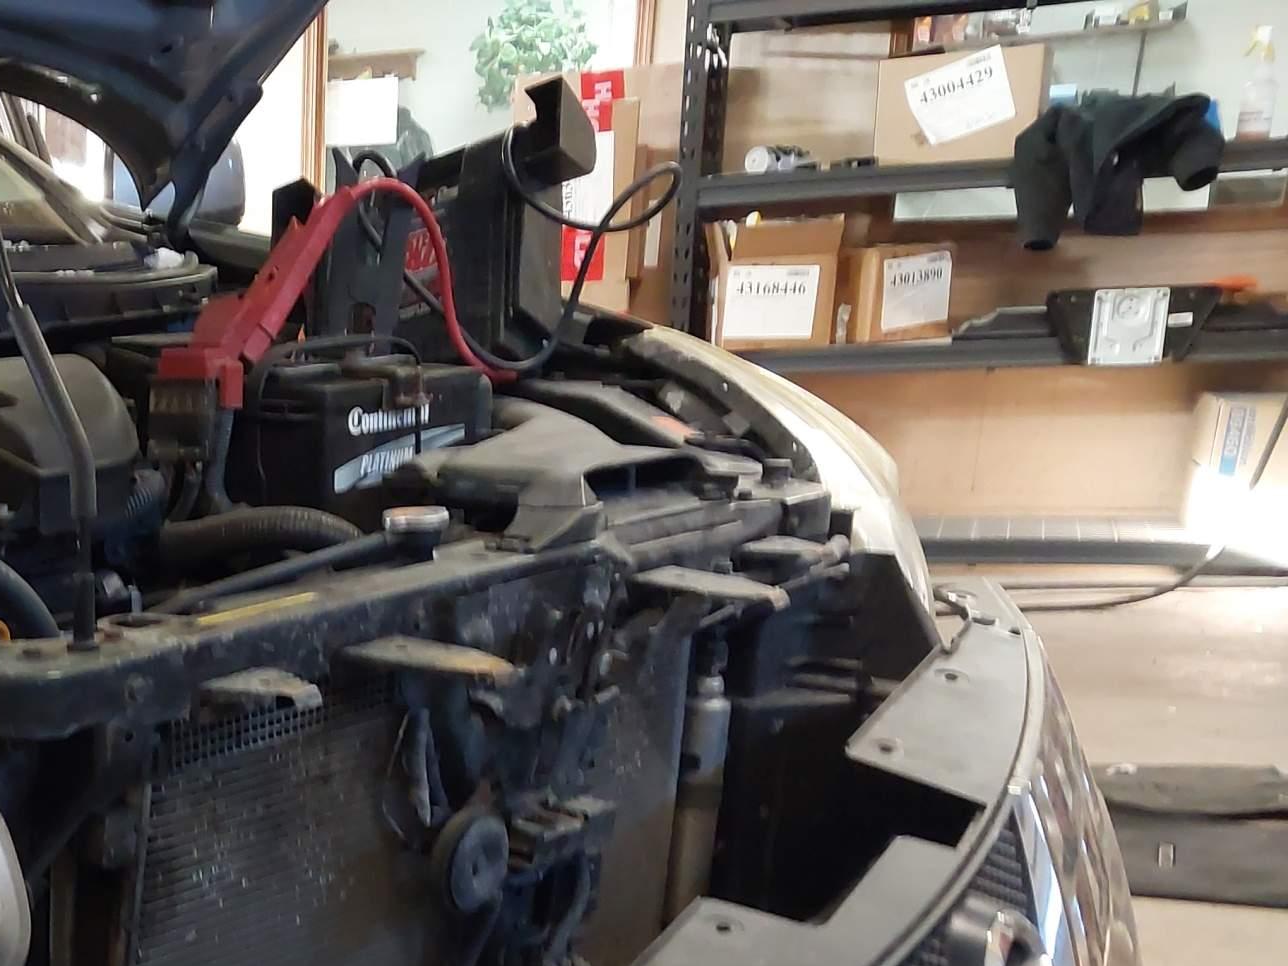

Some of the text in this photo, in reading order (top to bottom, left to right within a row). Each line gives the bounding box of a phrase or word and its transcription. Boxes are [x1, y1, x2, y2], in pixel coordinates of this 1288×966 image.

[920, 65, 993, 104] 43004429
[736, 280, 807, 295] 43168446
[890, 267, 943, 288] 43013890
